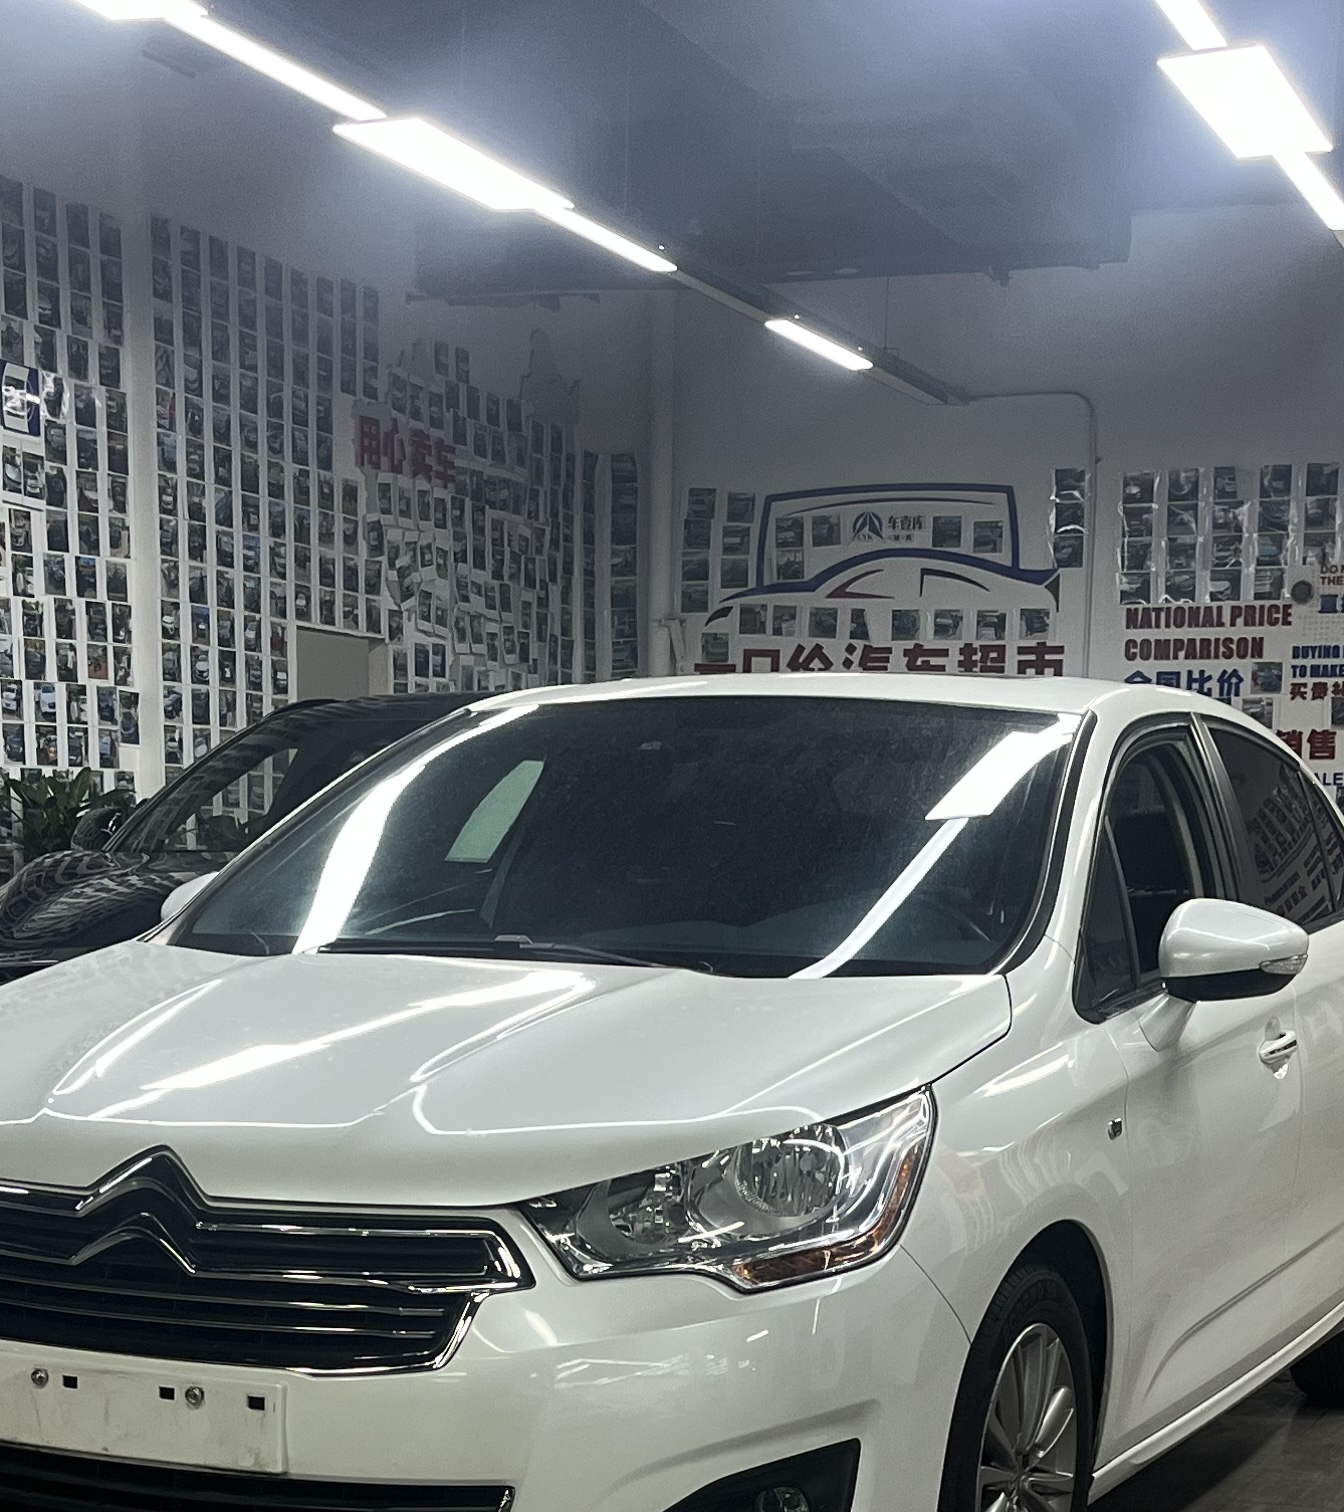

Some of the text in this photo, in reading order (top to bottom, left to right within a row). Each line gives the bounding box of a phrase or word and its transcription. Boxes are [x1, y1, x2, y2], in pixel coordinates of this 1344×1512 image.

[1320, 566, 1339, 575] DO
[1320, 576, 1344, 586] THE
[1125, 604, 1293, 630] NATIONAL PRICE
[1124, 637, 1265, 662] COMPARISON
[1292, 644, 1341, 660] BUYING
[1291, 664, 1308, 678] TO
